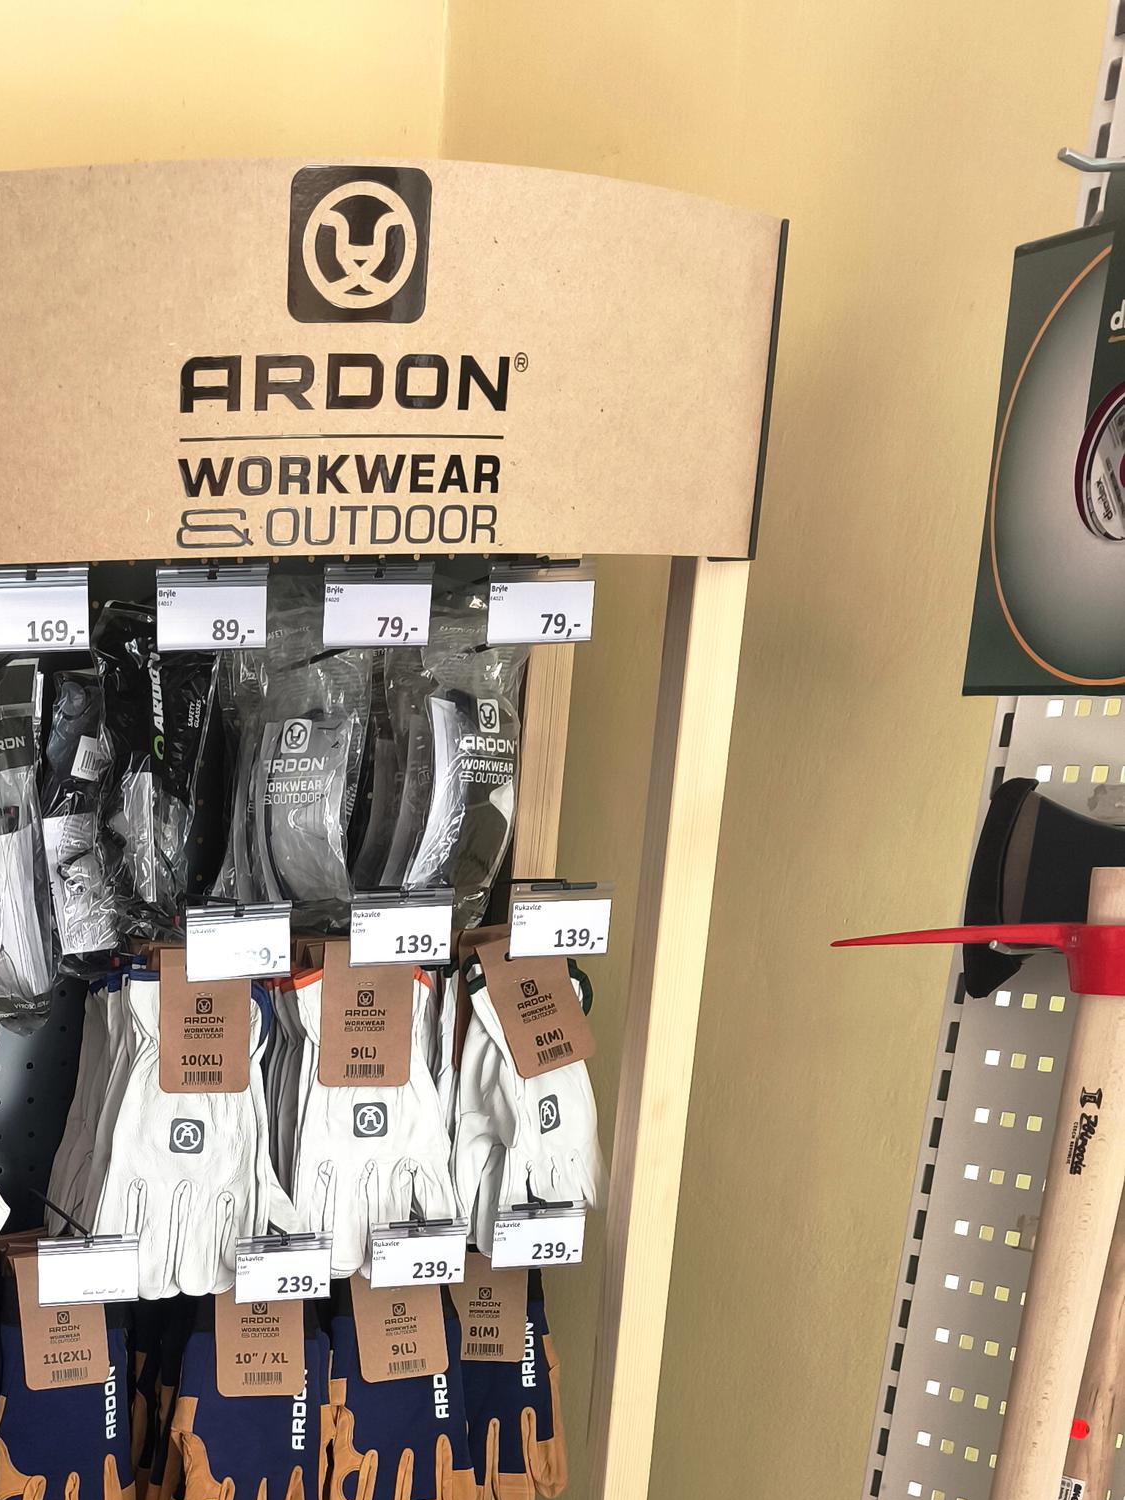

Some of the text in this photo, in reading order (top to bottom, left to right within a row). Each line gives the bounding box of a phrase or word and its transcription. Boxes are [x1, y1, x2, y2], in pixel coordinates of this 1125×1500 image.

[178, 454, 501, 498] WORKWEAR
[265, 505, 497, 547] OUTDOOR
[158, 589, 177, 599] Brýle
[326, 585, 344, 595] Brýle
[491, 584, 508, 594] Brýle
[27, 619, 85, 646] 169,-
[212, 619, 255, 644] 89,-
[377, 616, 418, 642] 79,-
[541, 613, 581, 638] 79,-
[460, 758, 514, 774] WORKWEAR
[395, 934, 447, 956] 139,-
[554, 928, 604, 950] 139,-
[517, 993, 552, 1011] ARDON
[184, 1016, 225, 1025] ARDON
[345, 1009, 386, 1017] ARDON
[535, 1027, 564, 1047] 8(M)
[181, 1053, 223, 1067] 10(XL)
[350, 1047, 377, 1060] 9(L)
[531, 1241, 579, 1262] 239,-
[412, 1260, 461, 1281] 239,-
[277, 1275, 327, 1295] 239,-
[241, 1316, 280, 1324] ARDON
[469, 1326, 500, 1338] 8(M)
[43, 1349, 92, 1365] 11(2XL)
[271, 1352, 289, 1364] XL
[391, 1341, 417, 1356] 9(L)
[104, 1365, 117, 1440] ARDON
[433, 1373, 450, 1419] ARD
